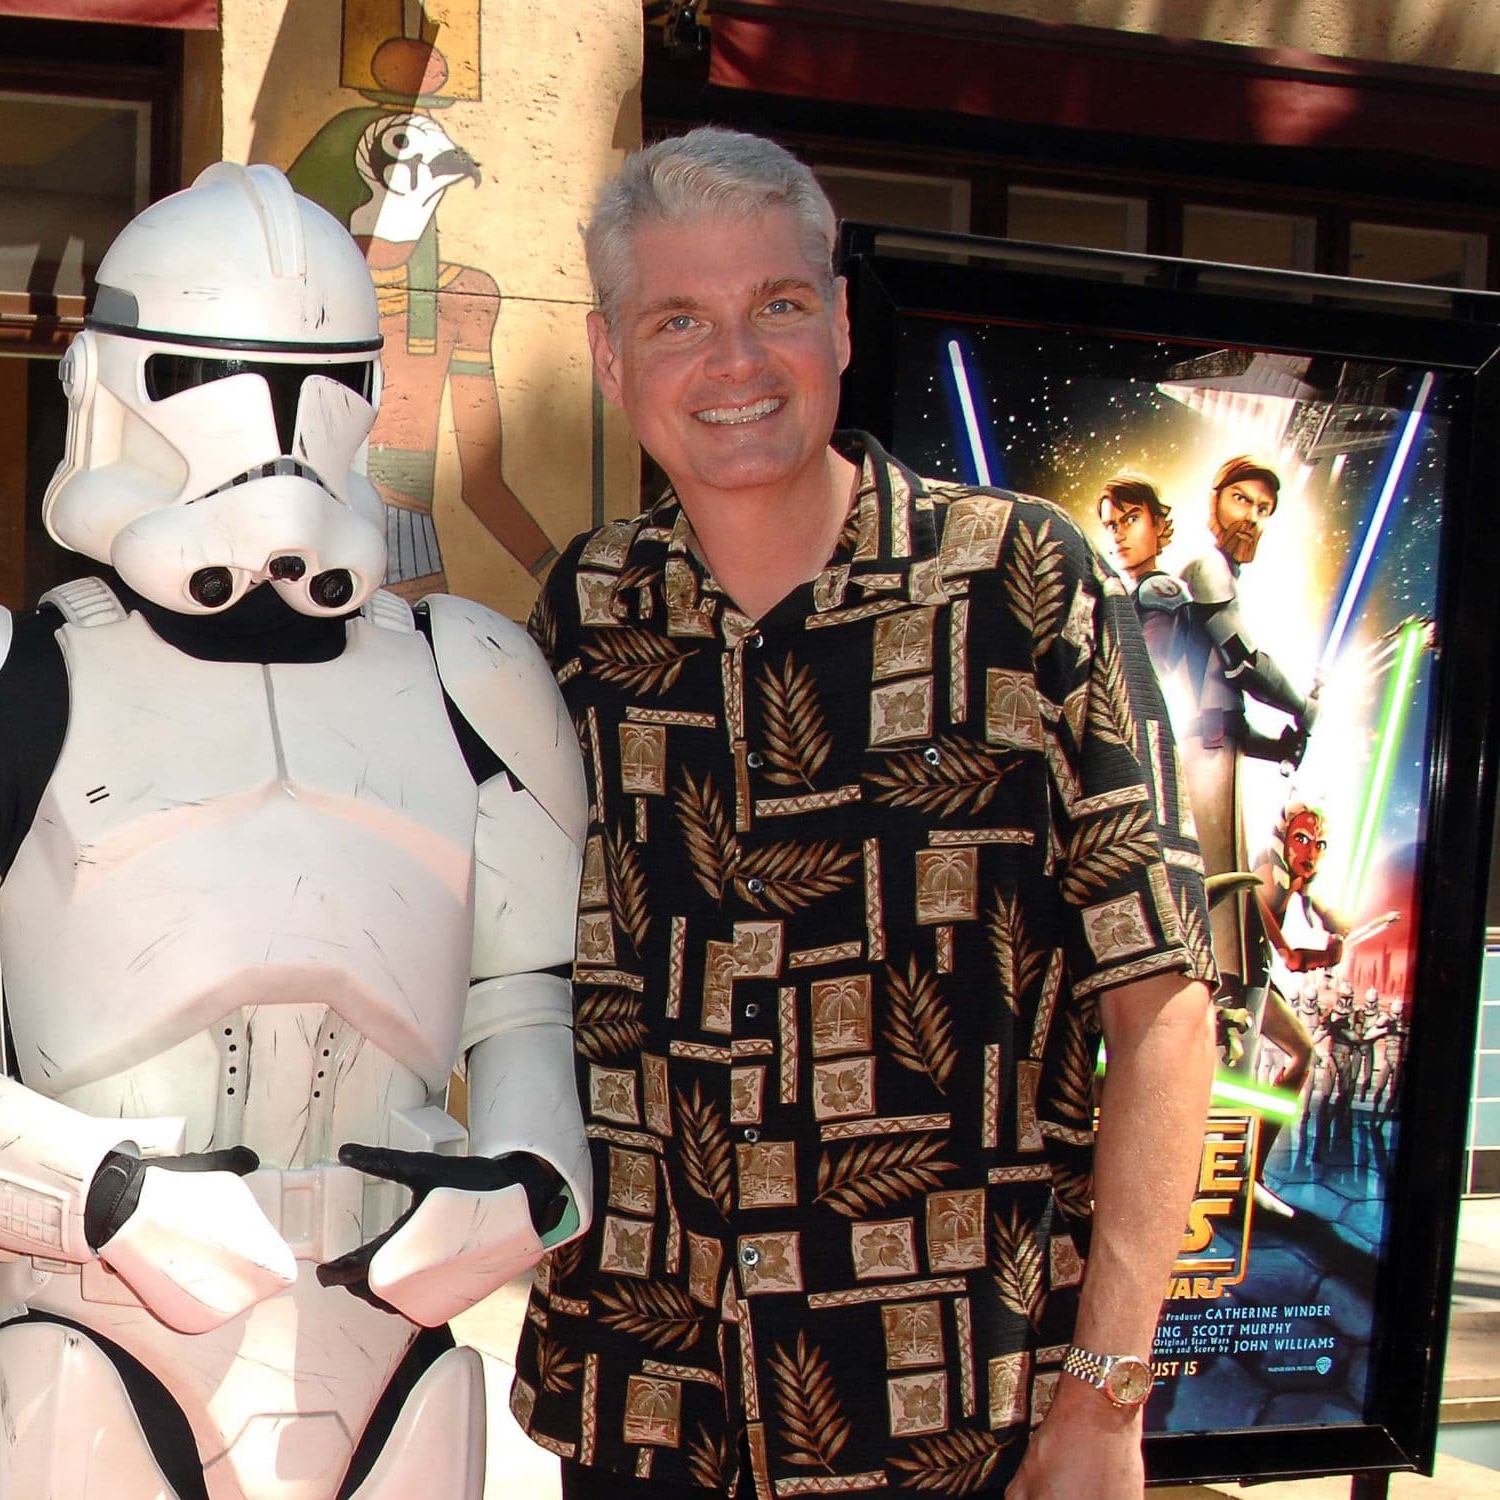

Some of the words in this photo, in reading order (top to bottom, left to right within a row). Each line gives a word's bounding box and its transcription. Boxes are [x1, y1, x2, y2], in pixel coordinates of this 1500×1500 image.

[1166, 1312, 1202, 1321] Producer
[1205, 1306, 1278, 1320] CATHERINE
[1284, 1305, 1331, 1318] WINDER
[1192, 1324, 1235, 1337] SCOTT
[1240, 1322, 1292, 1335] MURPHY
[1153, 1338, 1188, 1347] Original
[1191, 1338, 1208, 1346] Star
[1210, 1337, 1230, 1345] Wars
[1176, 1346, 1191, 1354] and
[1194, 1345, 1215, 1354] Score
[1218, 1345, 1229, 1354] by
[1233, 1340, 1268, 1354] JOHN
[1274, 1337, 1335, 1351] WILLIAMS
[1184, 1361, 1198, 1376] 15
